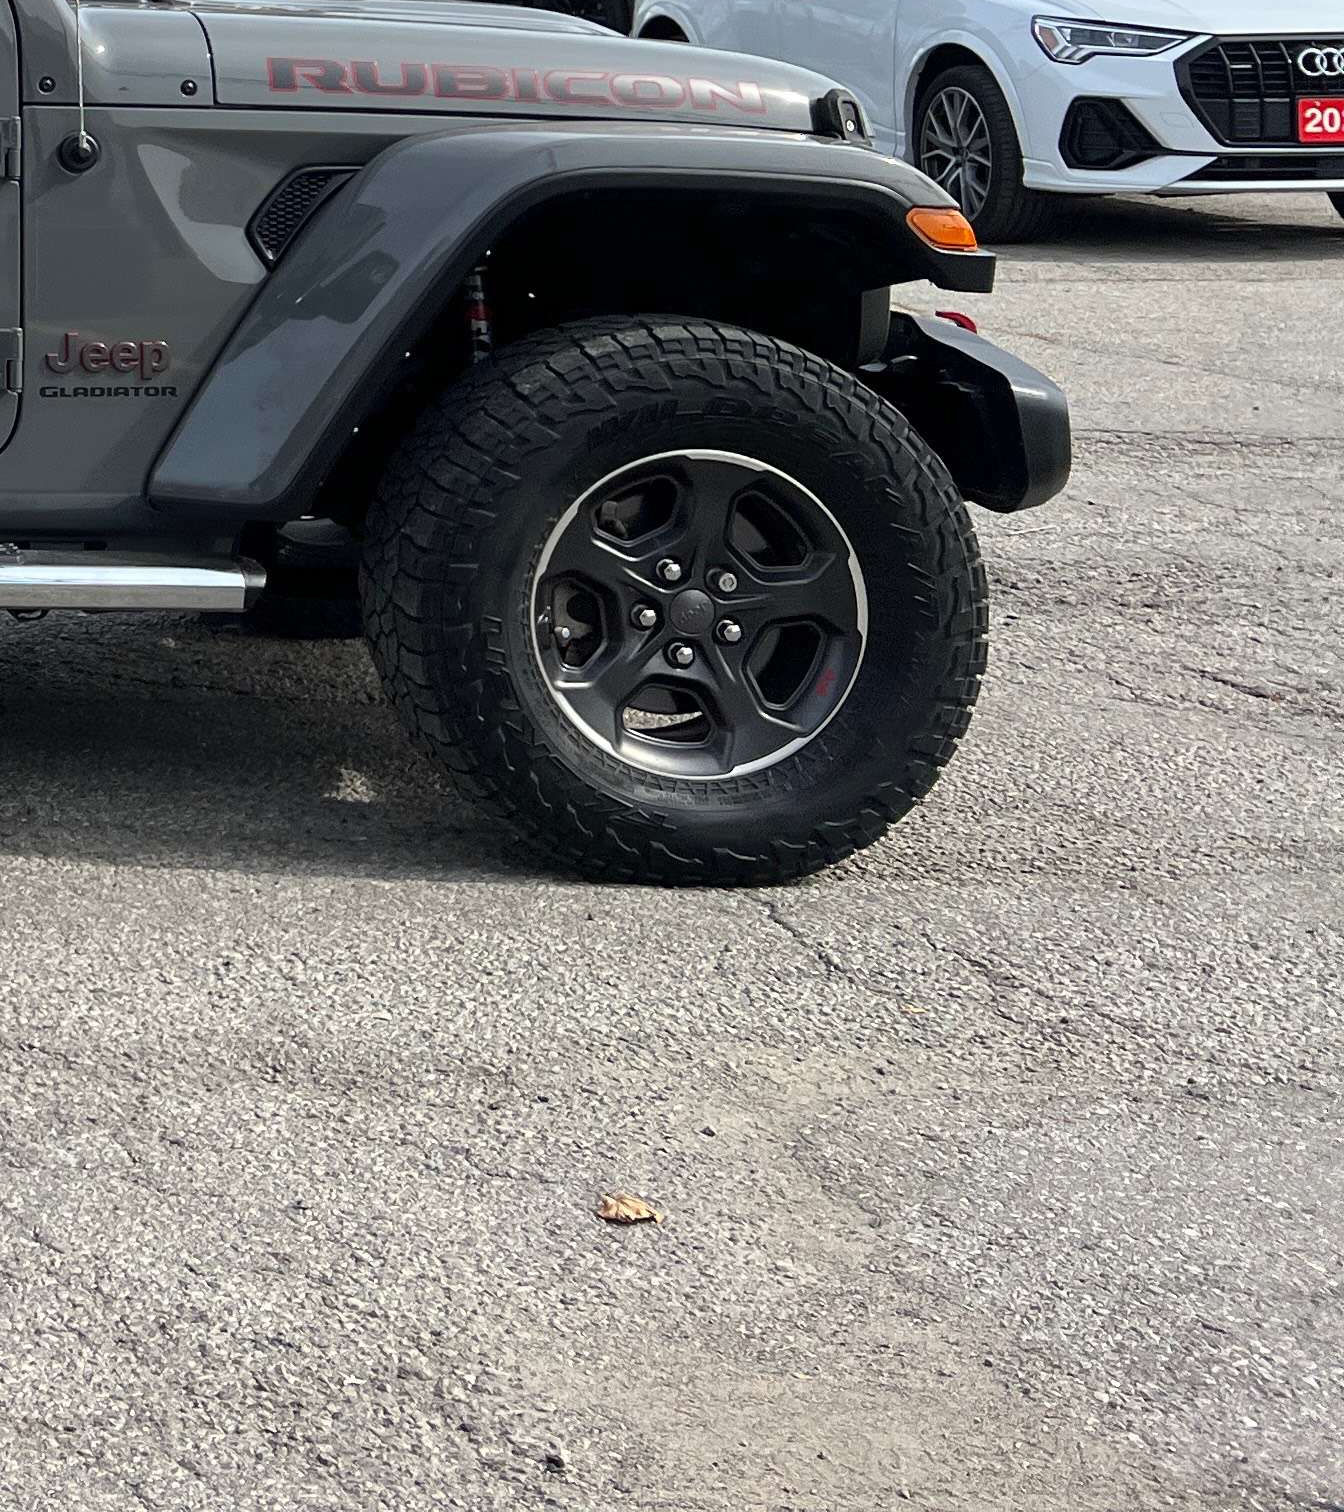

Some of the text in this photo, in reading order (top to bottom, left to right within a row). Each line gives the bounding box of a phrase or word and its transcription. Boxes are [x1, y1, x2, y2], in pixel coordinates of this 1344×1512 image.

[266, 57, 768, 115] RUBICON
[1304, 107, 1344, 133] 20
[45, 330, 170, 380] Jeep
[39, 386, 179, 398] GLADIATOR
